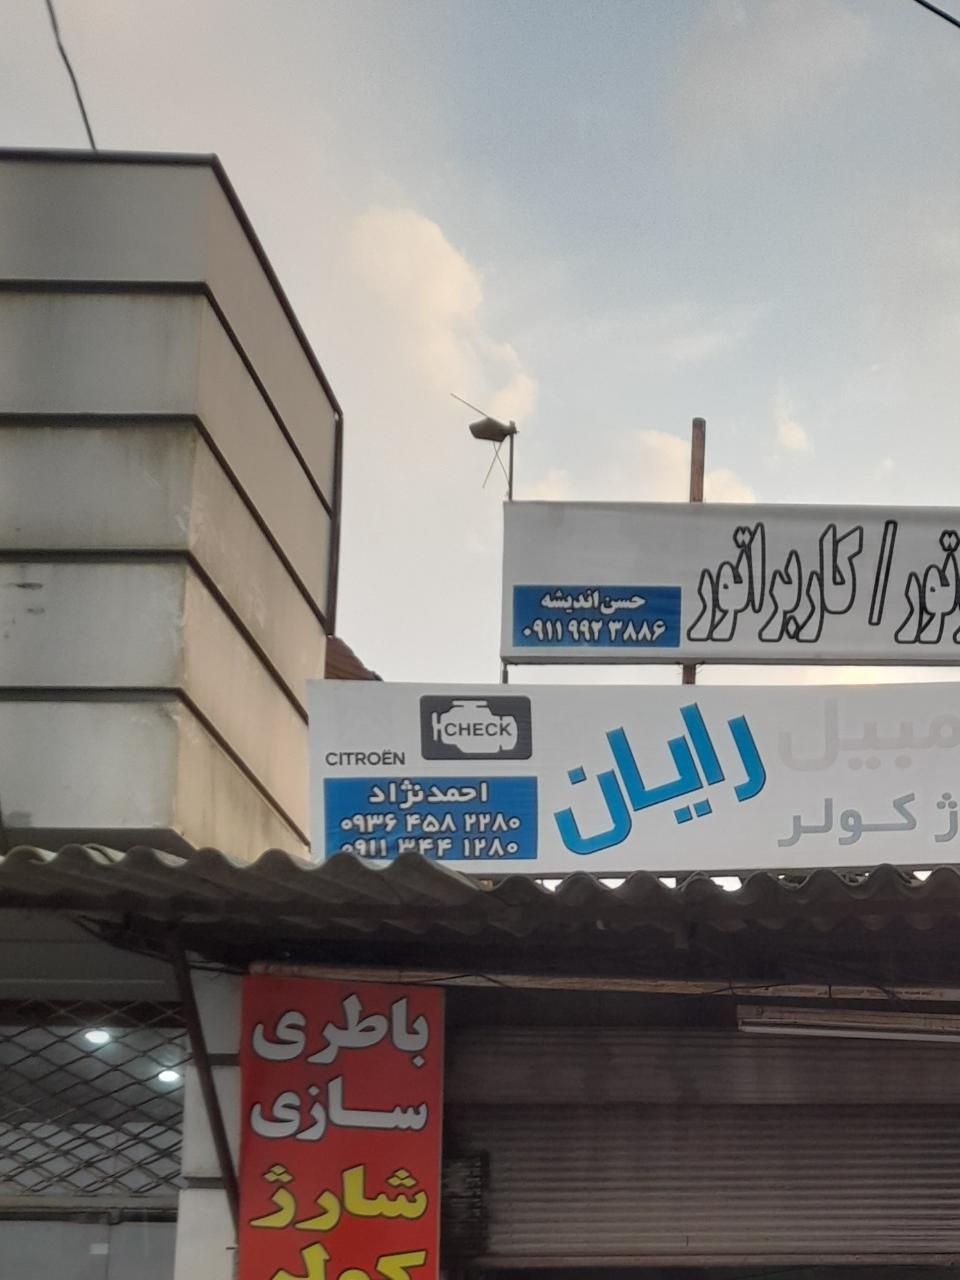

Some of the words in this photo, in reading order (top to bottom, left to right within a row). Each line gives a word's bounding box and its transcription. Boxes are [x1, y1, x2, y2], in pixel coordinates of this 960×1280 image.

[541, 589, 600, 613] اندیشه
[687, 522, 864, 643] کاربراتور
[601, 593, 646, 614] حسن
[444, 721, 513, 738] CHECK
[325, 749, 406, 767] CITROËN
[554, 702, 767, 856] رایان
[341, 813, 398, 834] ۰۹۳۶
[405, 813, 457, 833] ۴۵۸
[464, 812, 522, 833] ۲۲۸۰
[777, 792, 918, 847] کولر
[463, 837, 519, 858] ۱۲۸۰
[253, 993, 429, 1068] باطری
[250, 1076, 428, 1140] سازی
[249, 1163, 428, 1231] شارژ
